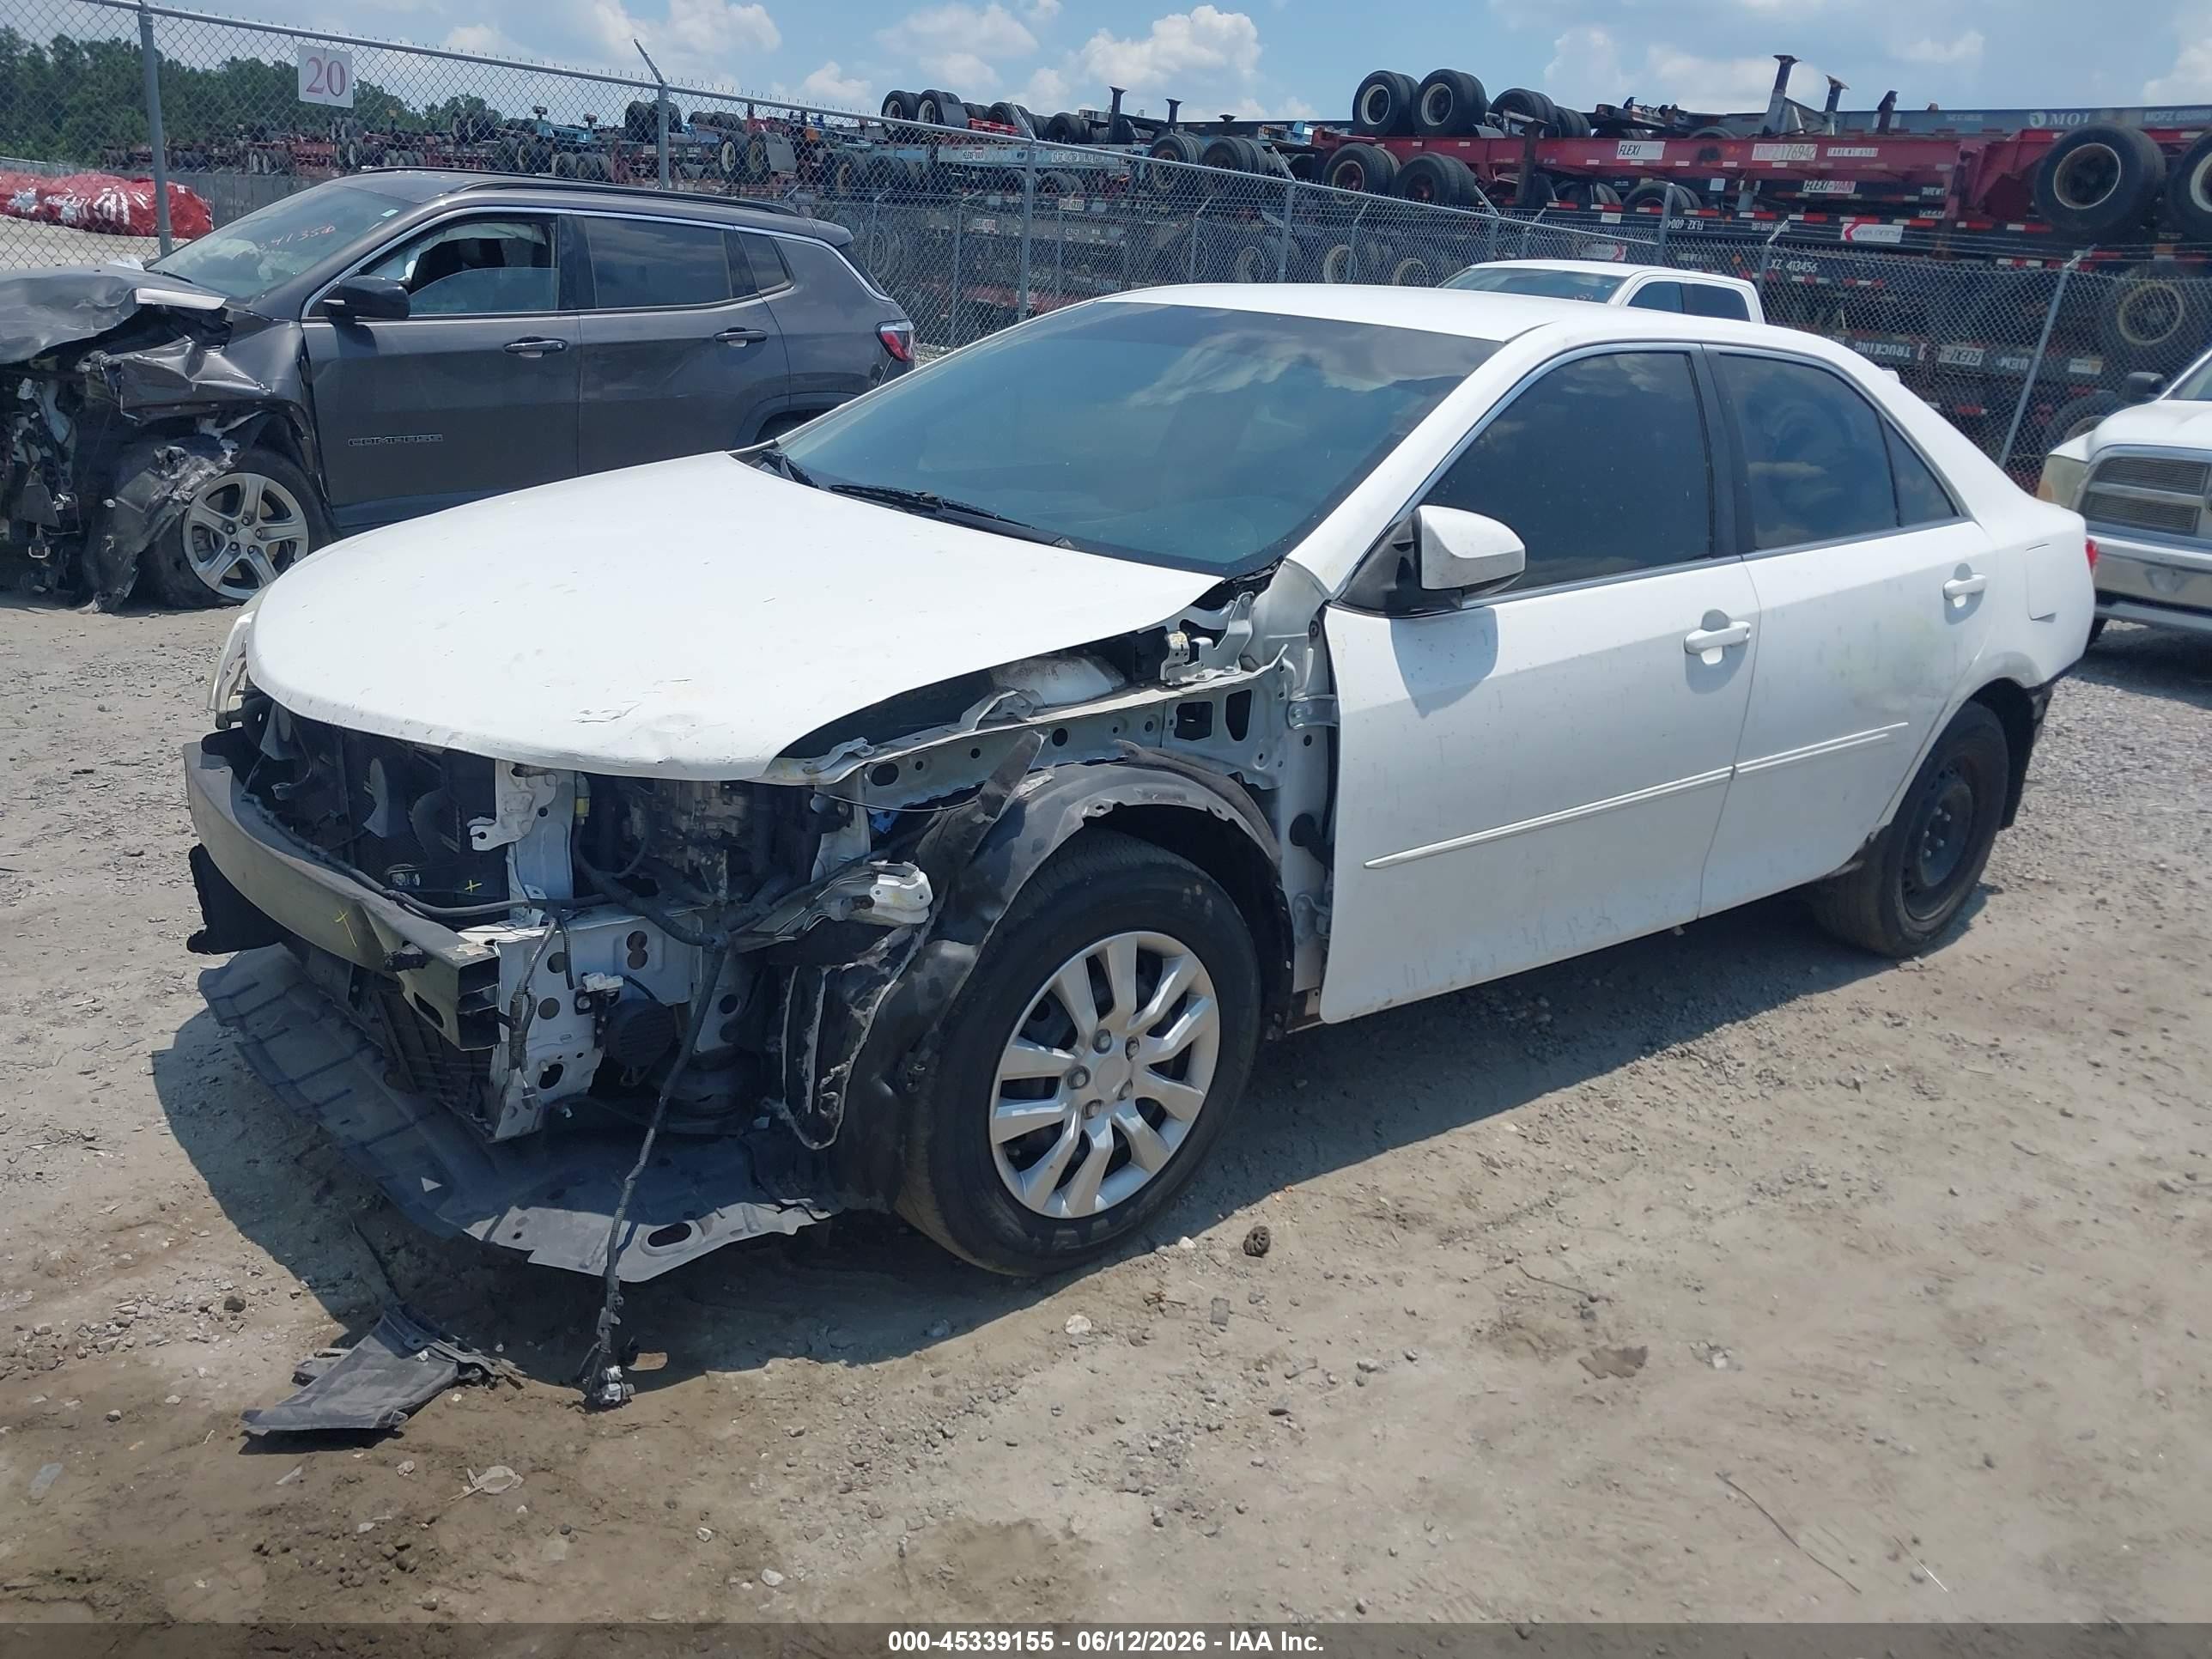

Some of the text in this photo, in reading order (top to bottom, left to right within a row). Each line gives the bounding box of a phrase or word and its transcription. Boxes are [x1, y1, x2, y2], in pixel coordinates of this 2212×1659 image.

[306, 57, 346, 97] 20
[1619, 144, 1641, 156] FLEXI
[1687, 219, 1705, 231] FLXZ
[1786, 260, 1818, 273] 413456
[1855, 342, 1911, 358] TRUCKING
[349, 434, 443, 447] COMPASS
